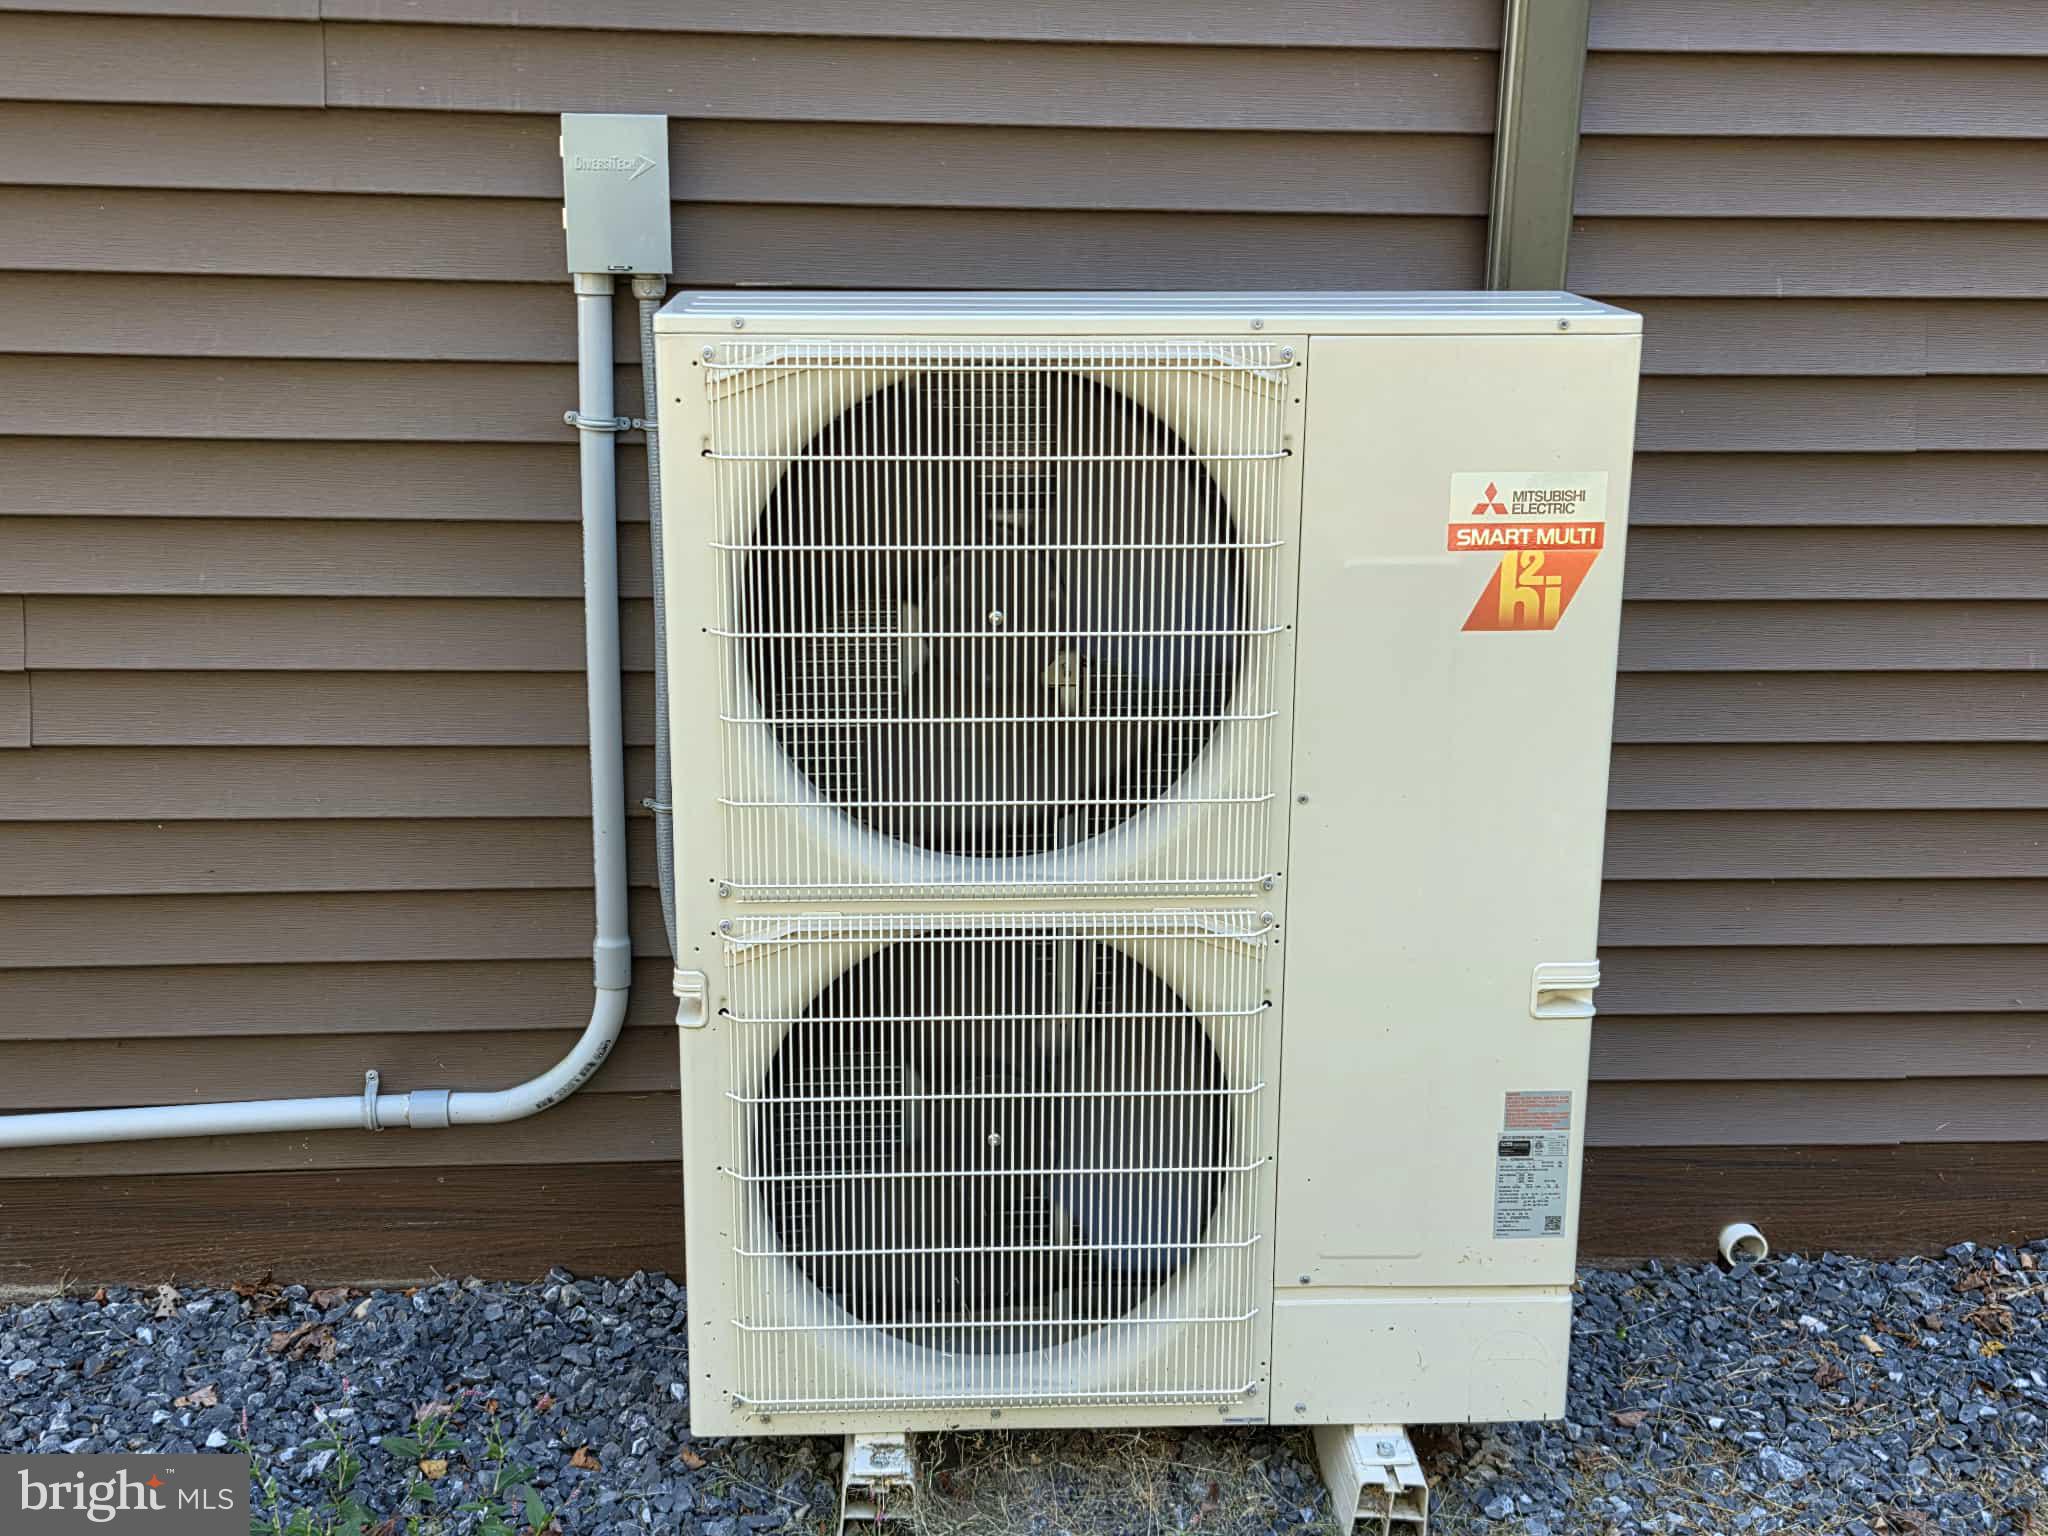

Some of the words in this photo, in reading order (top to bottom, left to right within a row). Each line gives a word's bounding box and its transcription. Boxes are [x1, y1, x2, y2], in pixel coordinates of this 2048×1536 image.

[1512, 490, 1586, 502] MITSUBISHI
[1512, 503, 1575, 515] ELECTRIC
[1456, 528, 1533, 546] SMART
[1536, 527, 1596, 545] MULTI
